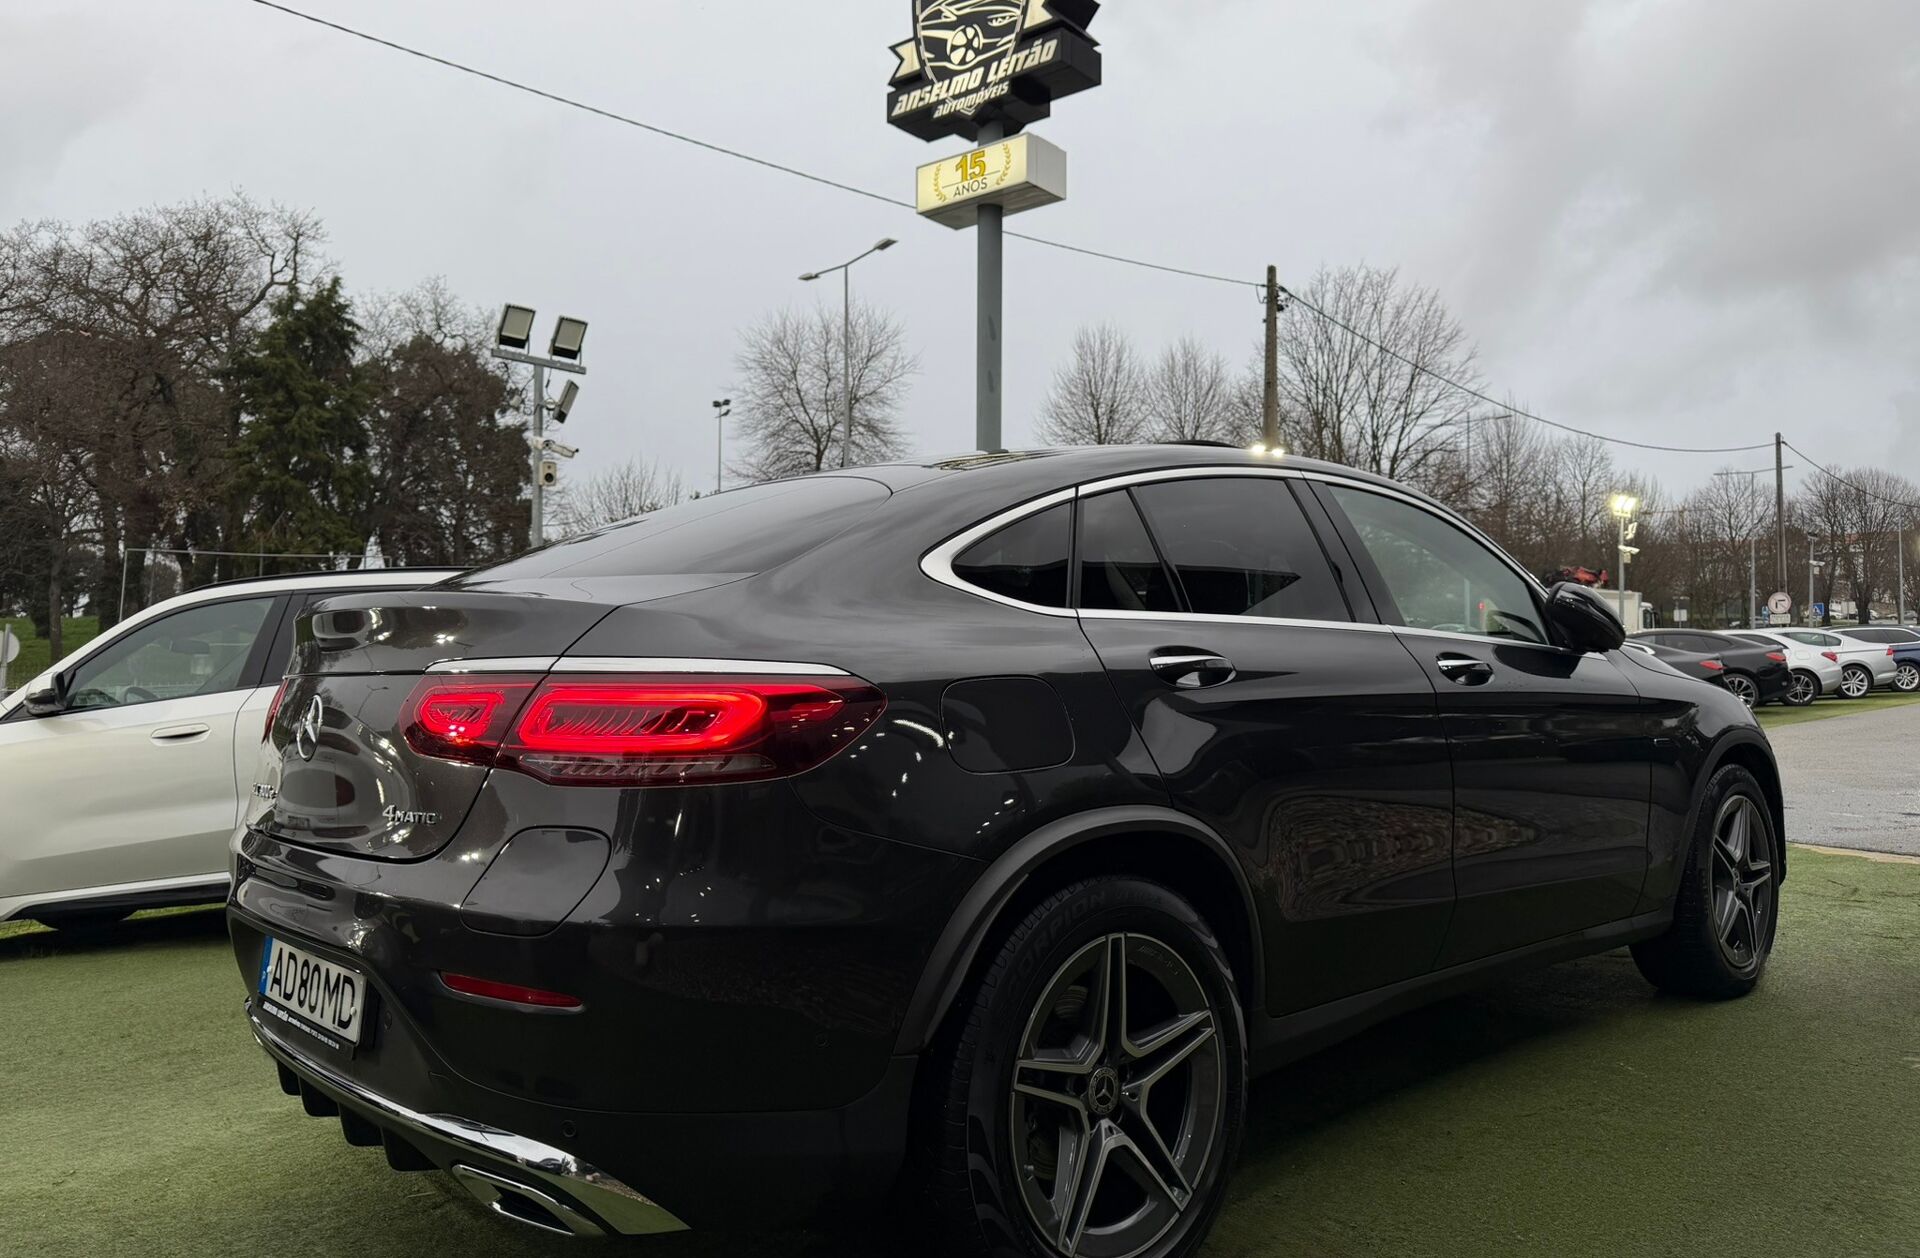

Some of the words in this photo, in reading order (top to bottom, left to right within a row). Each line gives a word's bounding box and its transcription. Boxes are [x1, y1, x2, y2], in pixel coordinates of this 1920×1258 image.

[891, 66, 985, 116] ANSELMO
[955, 150, 987, 183] 15
[953, 177, 988, 198] ANOS
[382, 804, 437, 825] 4MATIC
[270, 947, 356, 1029] AD80MD
